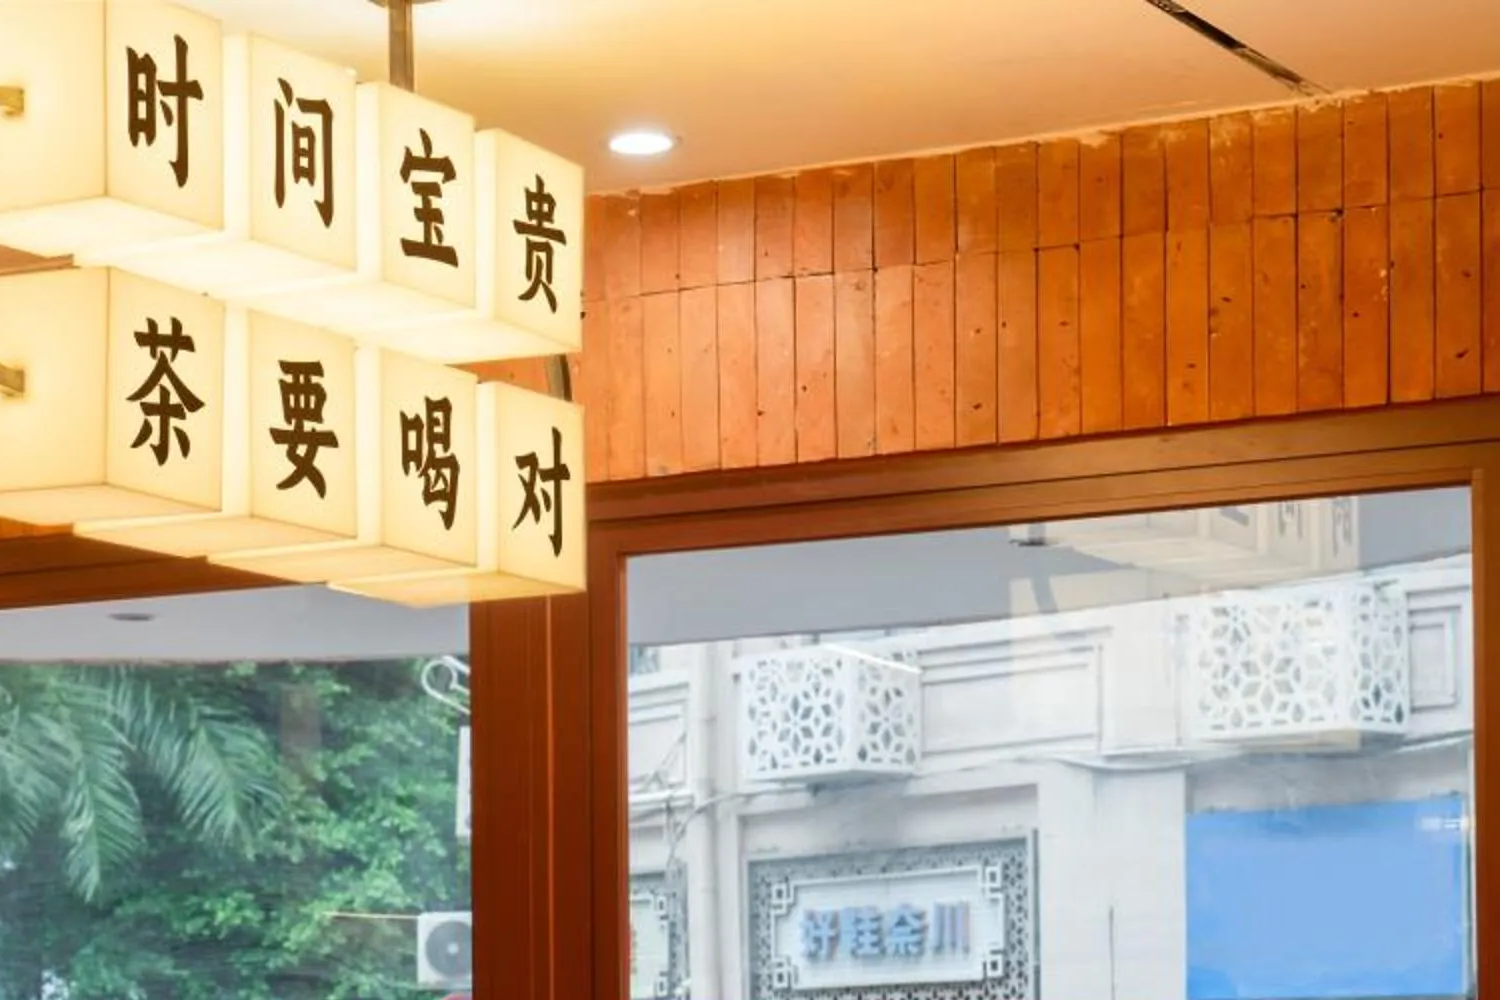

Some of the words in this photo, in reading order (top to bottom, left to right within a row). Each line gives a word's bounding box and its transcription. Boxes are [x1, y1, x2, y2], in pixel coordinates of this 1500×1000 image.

[127, 35, 567, 314] 时间宝贵
[127, 316, 571, 559] 茶要喝对
